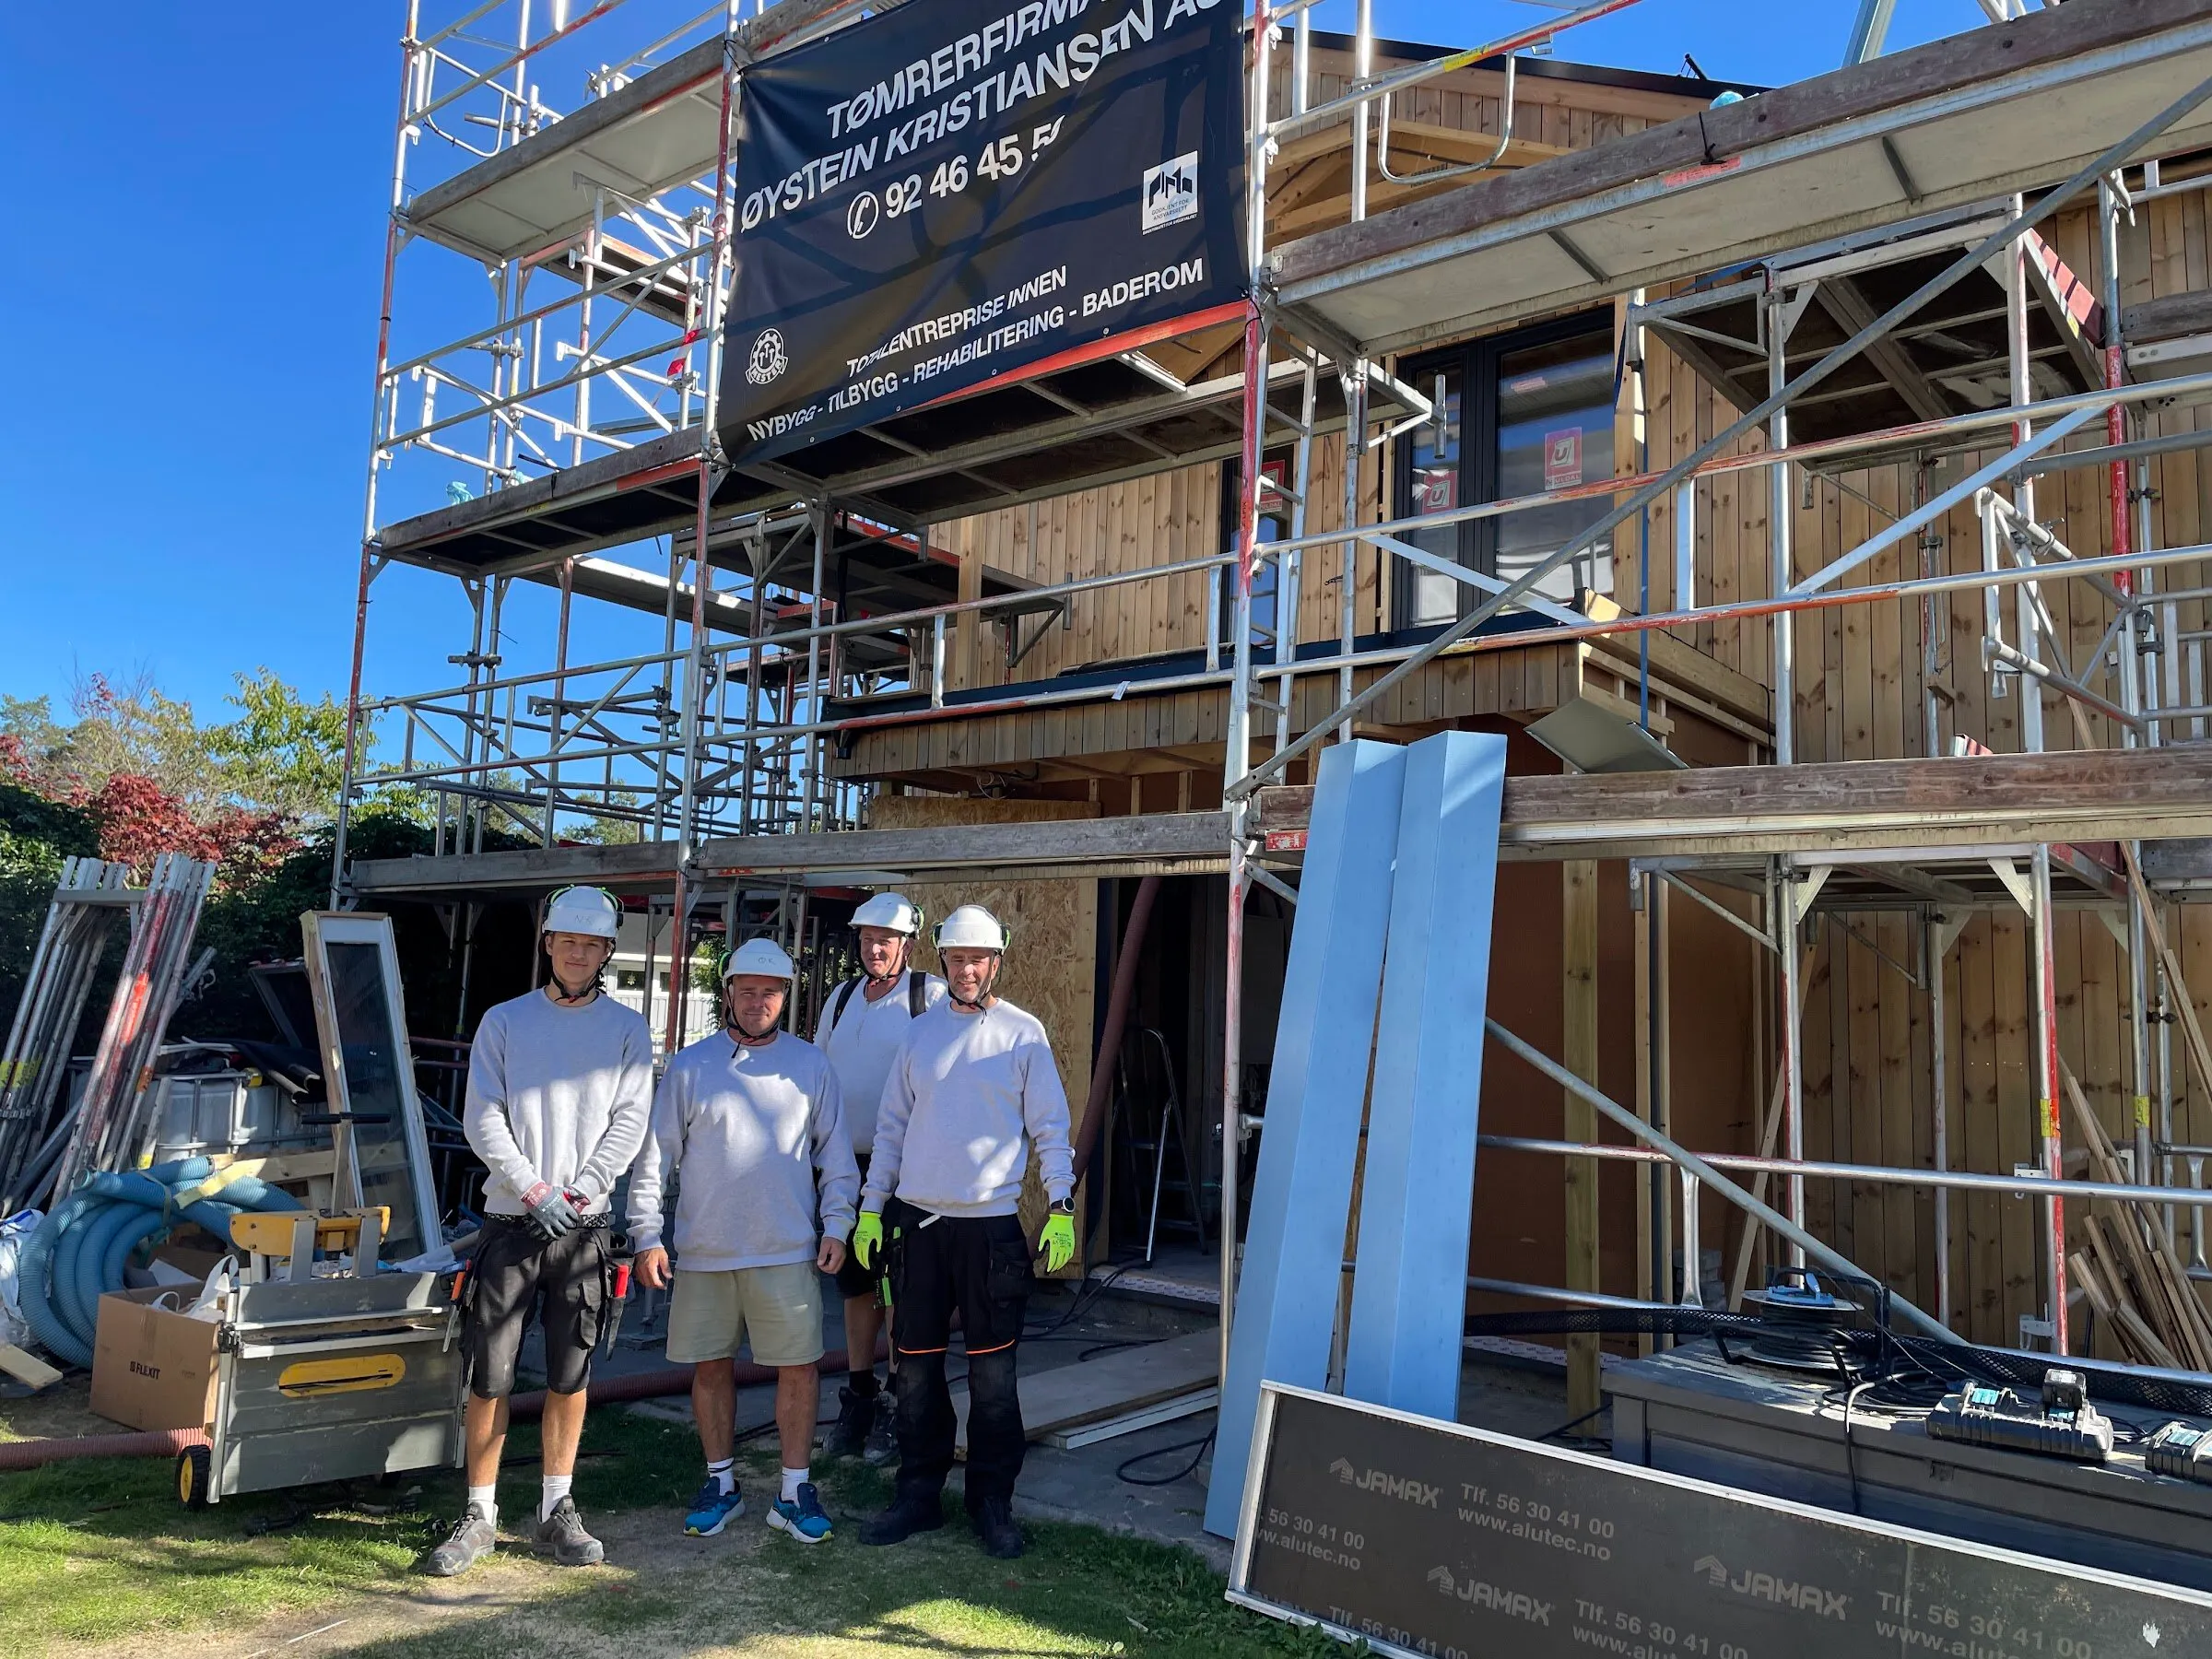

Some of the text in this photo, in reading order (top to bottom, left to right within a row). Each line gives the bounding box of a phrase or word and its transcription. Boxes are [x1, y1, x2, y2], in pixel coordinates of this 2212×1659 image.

[826, 0, 1107, 139] TØMRERFIRM
[740, 135, 879, 234] ØYSTEIN
[1163, 0, 1225, 30] A
[885, 173, 923, 218] 92
[929, 154, 969, 199] 46
[976, 134, 1023, 182] 45
[746, 405, 818, 441] NYBYGG
[828, 371, 899, 414] TILBYGG
[912, 305, 1064, 385] REHABILITERING
[1082, 257, 1203, 318] BADEROM
[845, 265, 1067, 378] TOTALENTREPRISE INNEN
[135, 1363, 160, 1379] FLEXIT
[1355, 1468, 1439, 1509] JAMAX
[1460, 1482, 1615, 1539] Tlf. 56 30 41 00
[1268, 1508, 1289, 1527] 56
[1292, 1515, 1314, 1535] 30
[1317, 1524, 1337, 1543] 41
[1342, 1531, 1366, 1551] 00
[1456, 1507, 1612, 1561] www.alutec.no
[1455, 1578, 1551, 1627] JAMAX
[1730, 1570, 1847, 1621] JAMAX
[1360, 1618, 1383, 1638] 56
[1387, 1626, 1411, 1648] 30
[1416, 1636, 1437, 1658] 41
[1574, 1597, 1608, 1625] Tlf.
[1615, 1611, 1642, 1635] 56
[1648, 1621, 1677, 1645] 30
[1682, 1632, 1710, 1655] 41
[1927, 1604, 1960, 1630] 56
[1969, 1615, 2004, 1641] 30
[2011, 1626, 2043, 1651] 41
[2056, 1636, 2092, 1659] 00
